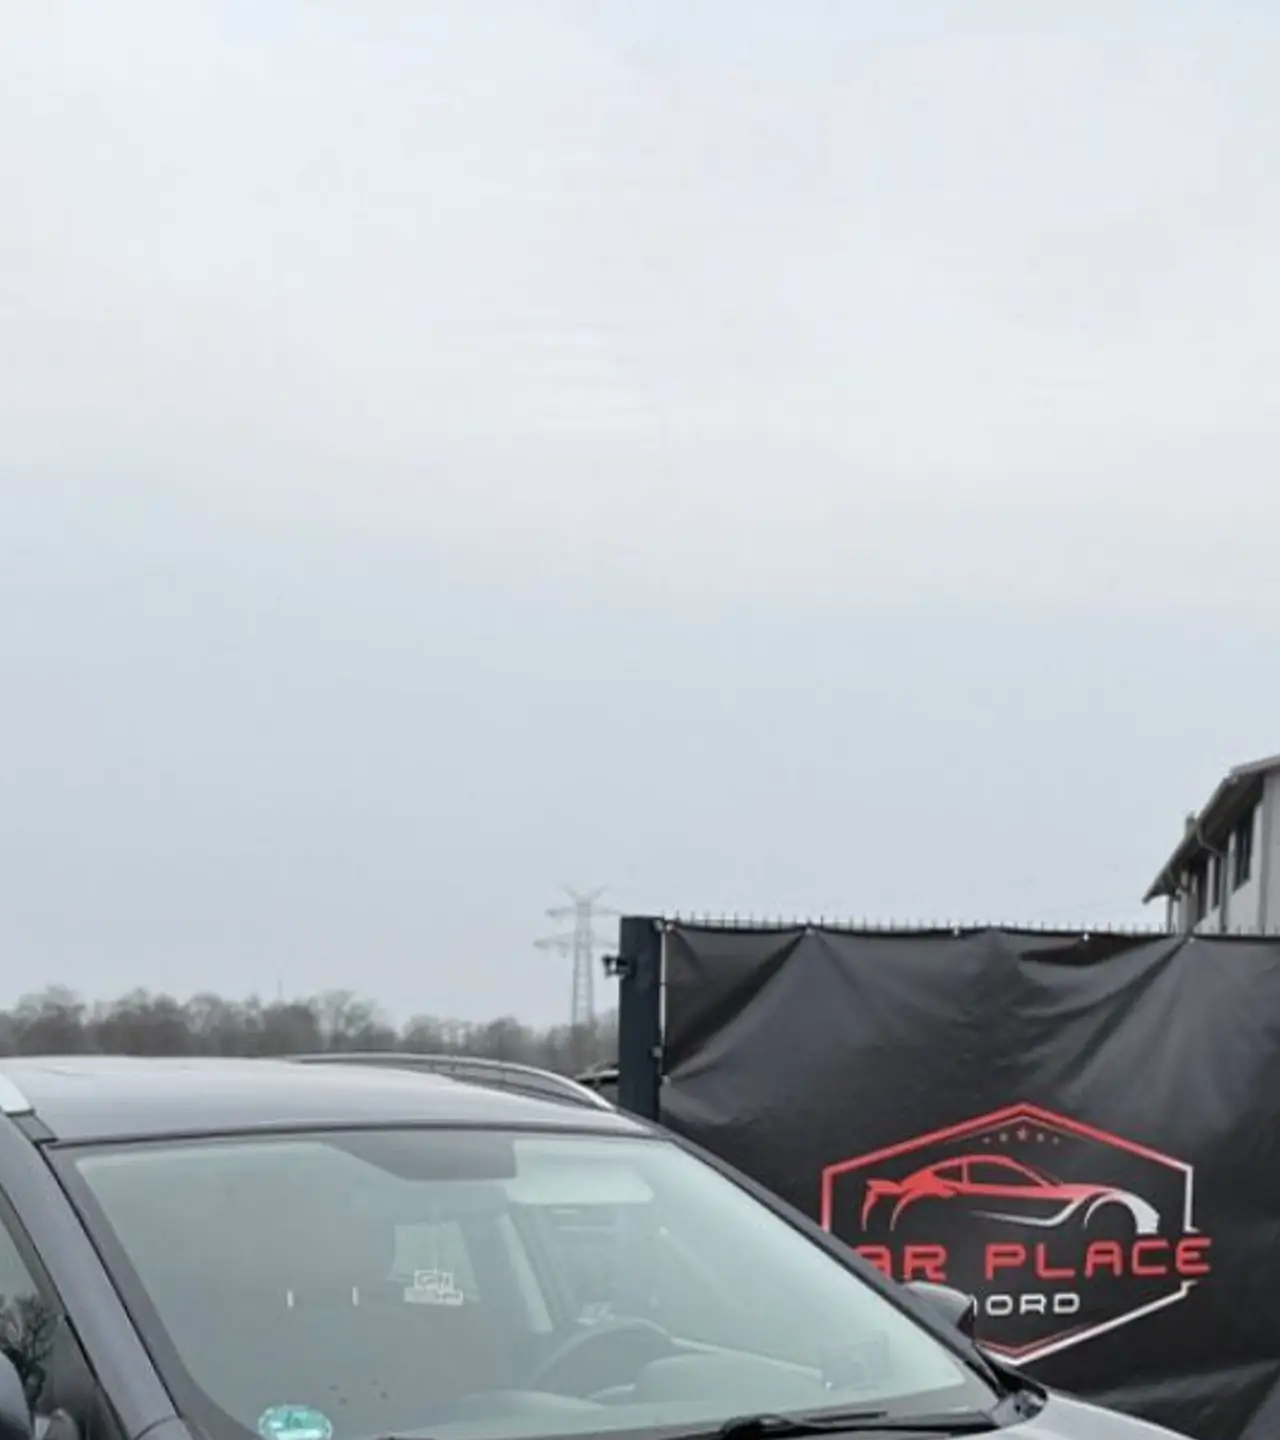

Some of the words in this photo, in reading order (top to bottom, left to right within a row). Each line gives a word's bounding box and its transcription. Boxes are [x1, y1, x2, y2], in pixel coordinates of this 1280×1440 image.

[853, 1243, 948, 1282] AR
[984, 1238, 1212, 1280] PLACE
[972, 1291, 1080, 1316] ORD
